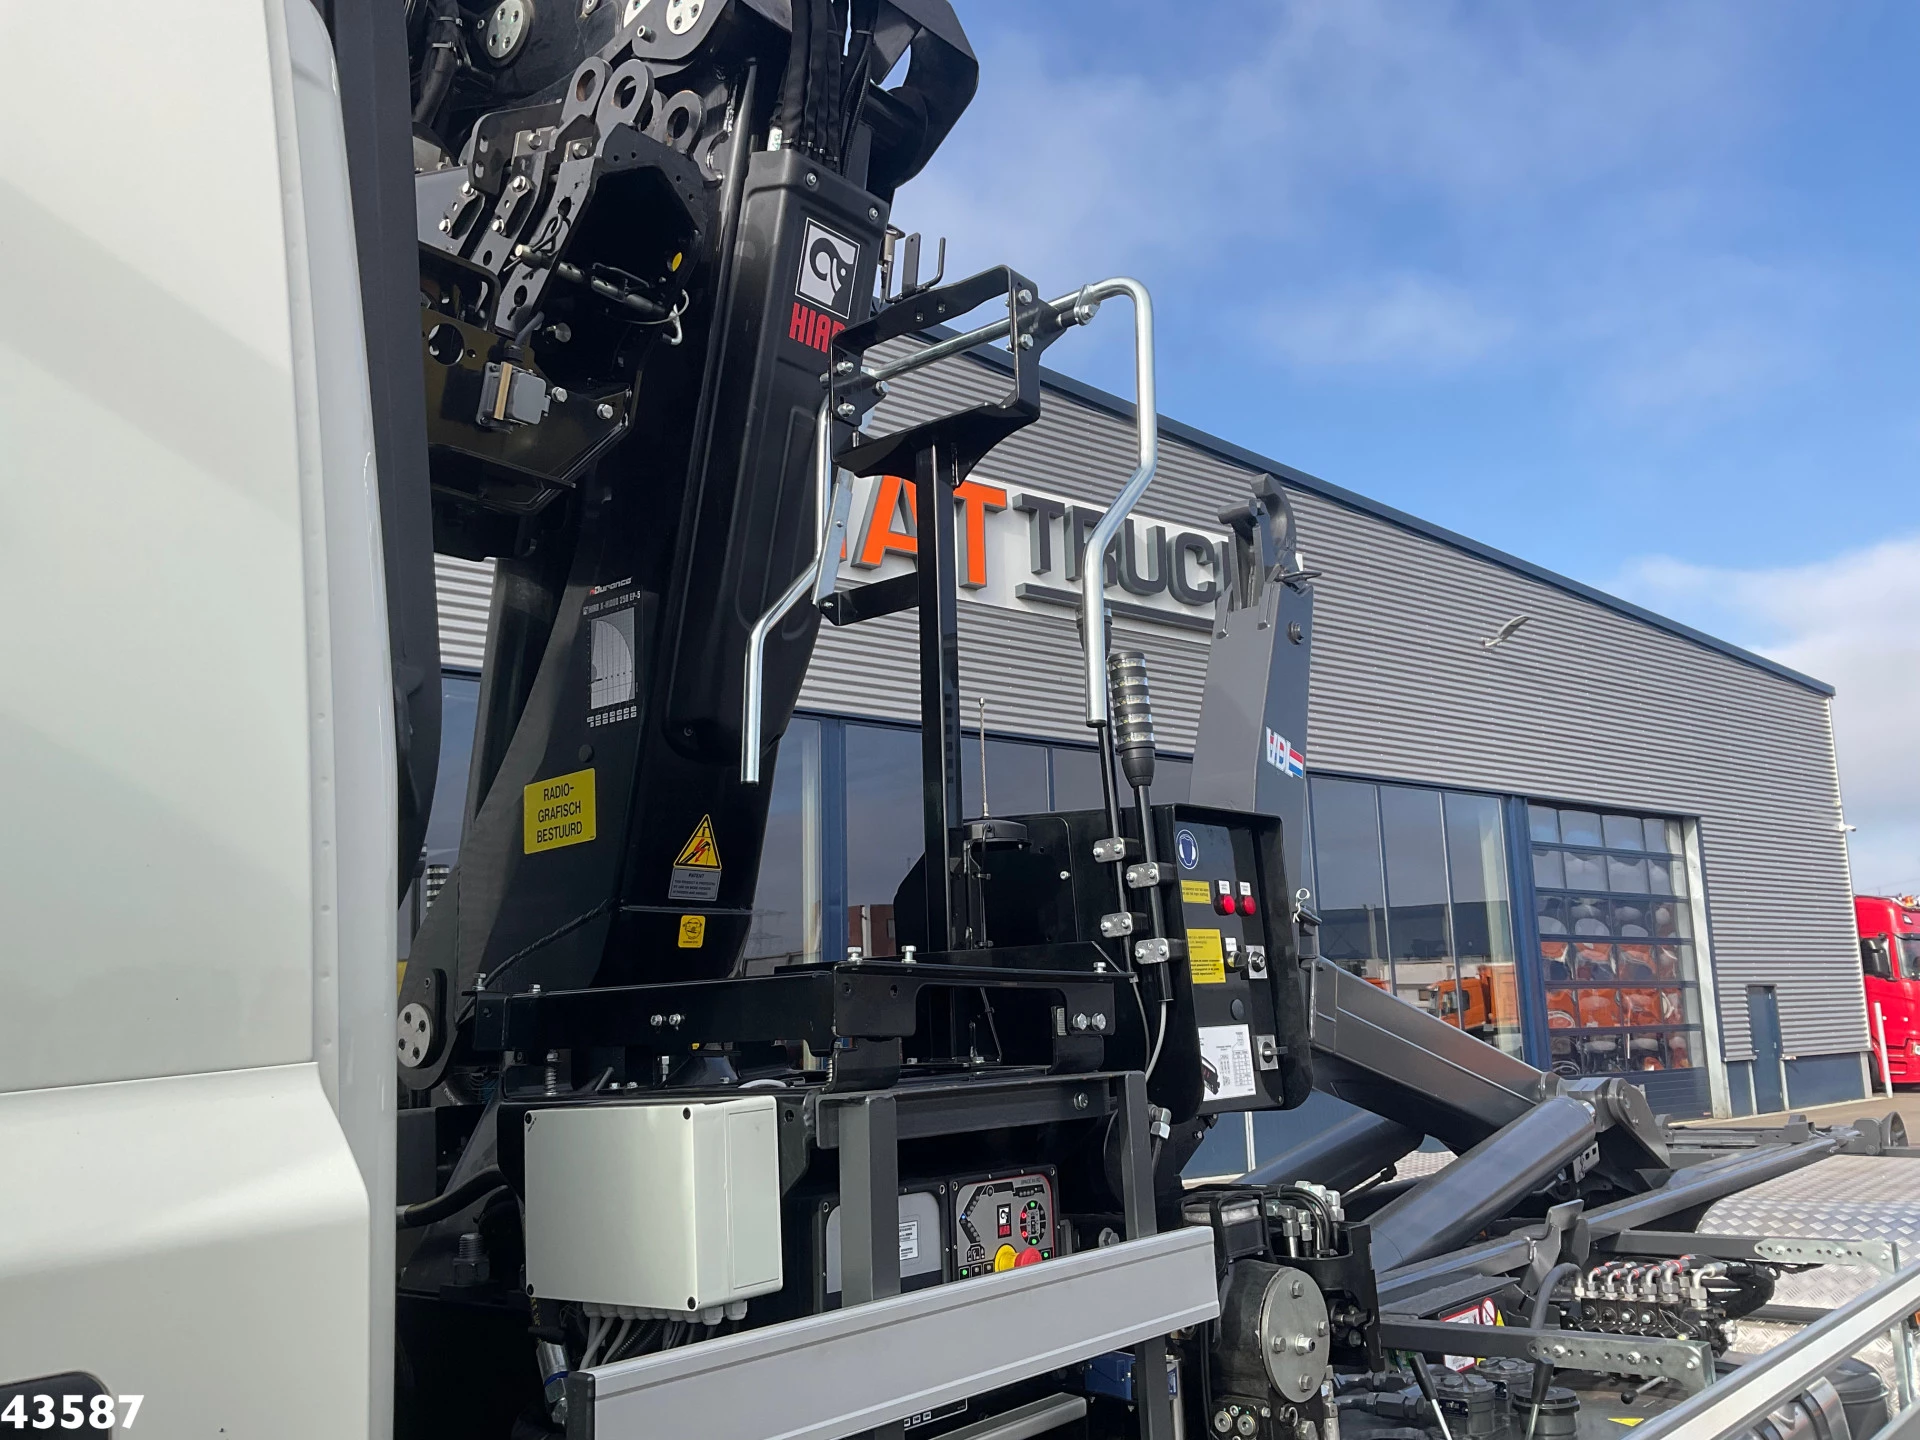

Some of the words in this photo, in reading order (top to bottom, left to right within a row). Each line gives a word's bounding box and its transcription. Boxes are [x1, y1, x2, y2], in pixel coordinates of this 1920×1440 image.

[840, 474, 1007, 590] AT
[1266, 727, 1297, 778] VDL
[543, 783, 574, 802] RADIO-
[538, 800, 582, 823] GRAFISCH
[537, 821, 582, 844] BESTUURD
